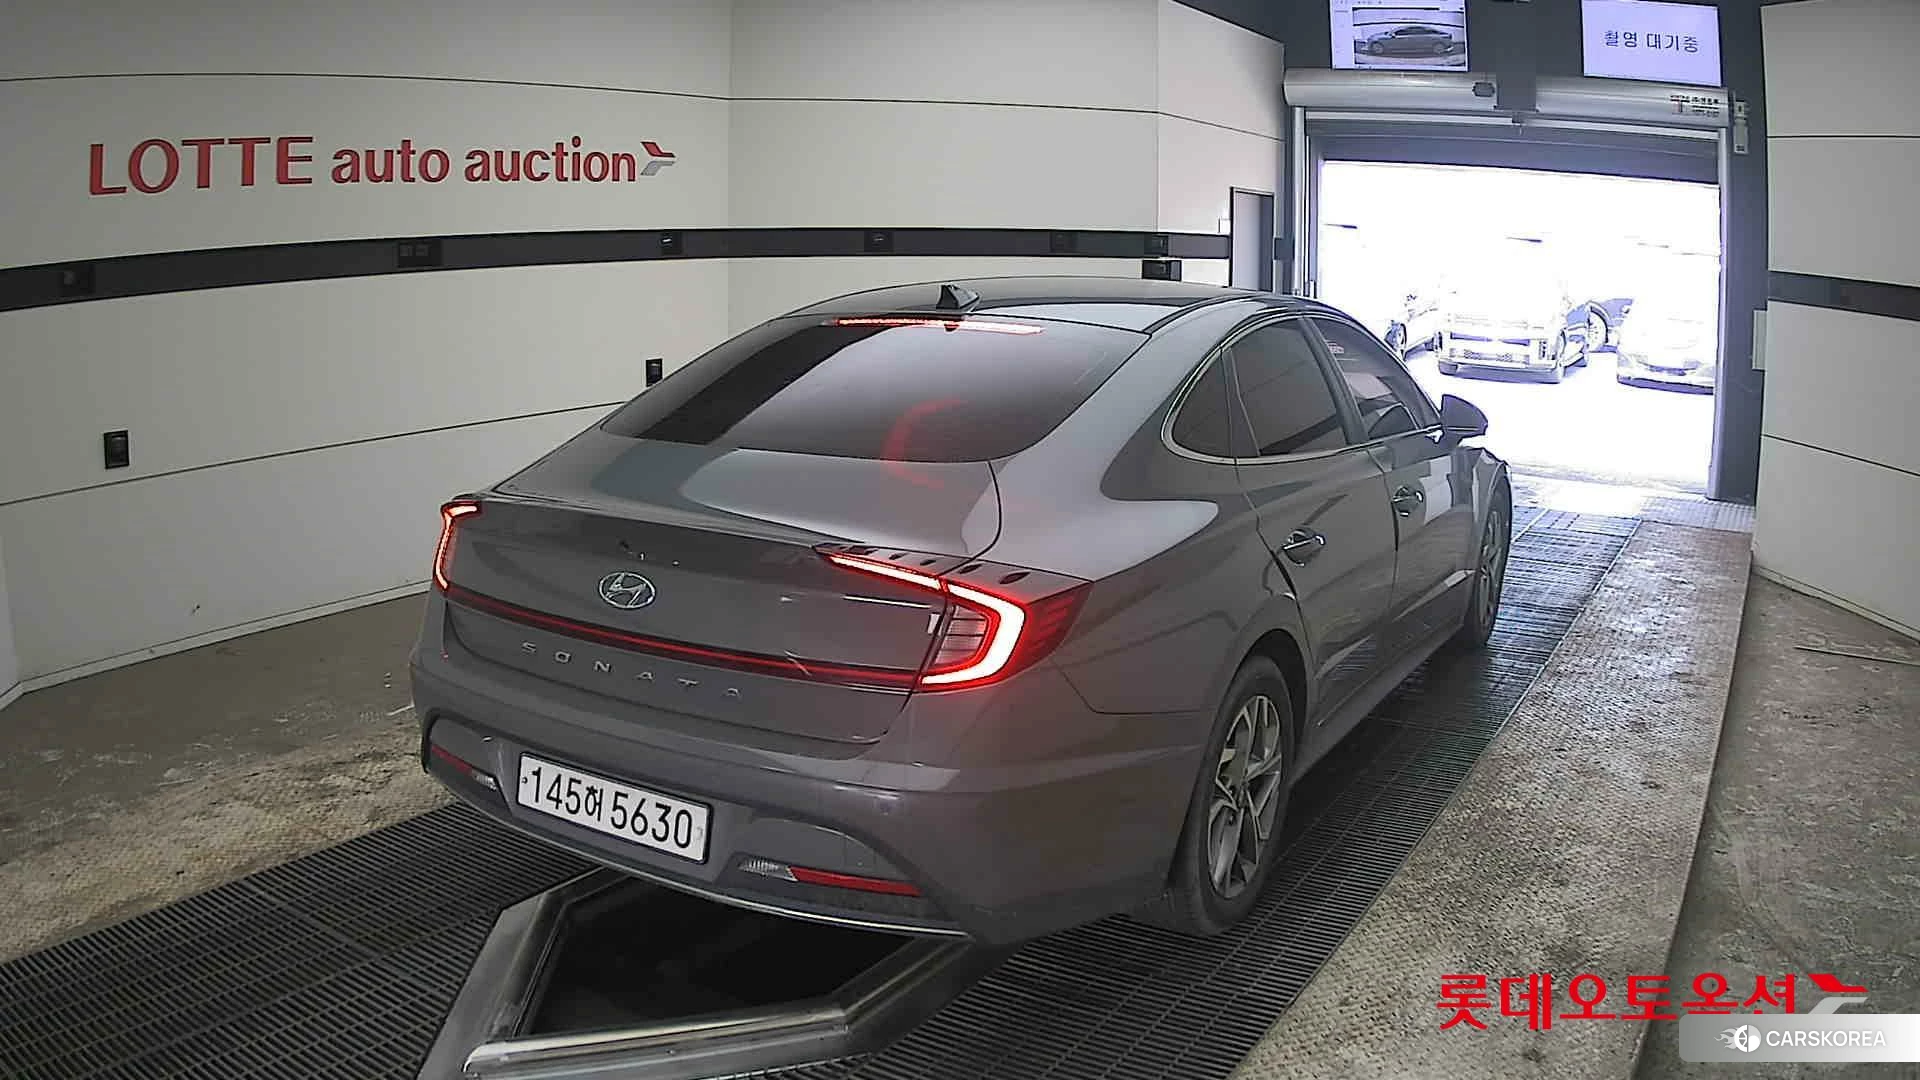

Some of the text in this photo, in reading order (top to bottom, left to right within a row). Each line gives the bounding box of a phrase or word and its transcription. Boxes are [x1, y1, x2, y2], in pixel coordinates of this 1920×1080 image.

[1646, 33, 1698, 53] 대기중
[90, 136, 636, 195] LOTTE auto auction
[611, 791, 692, 849] 5630
